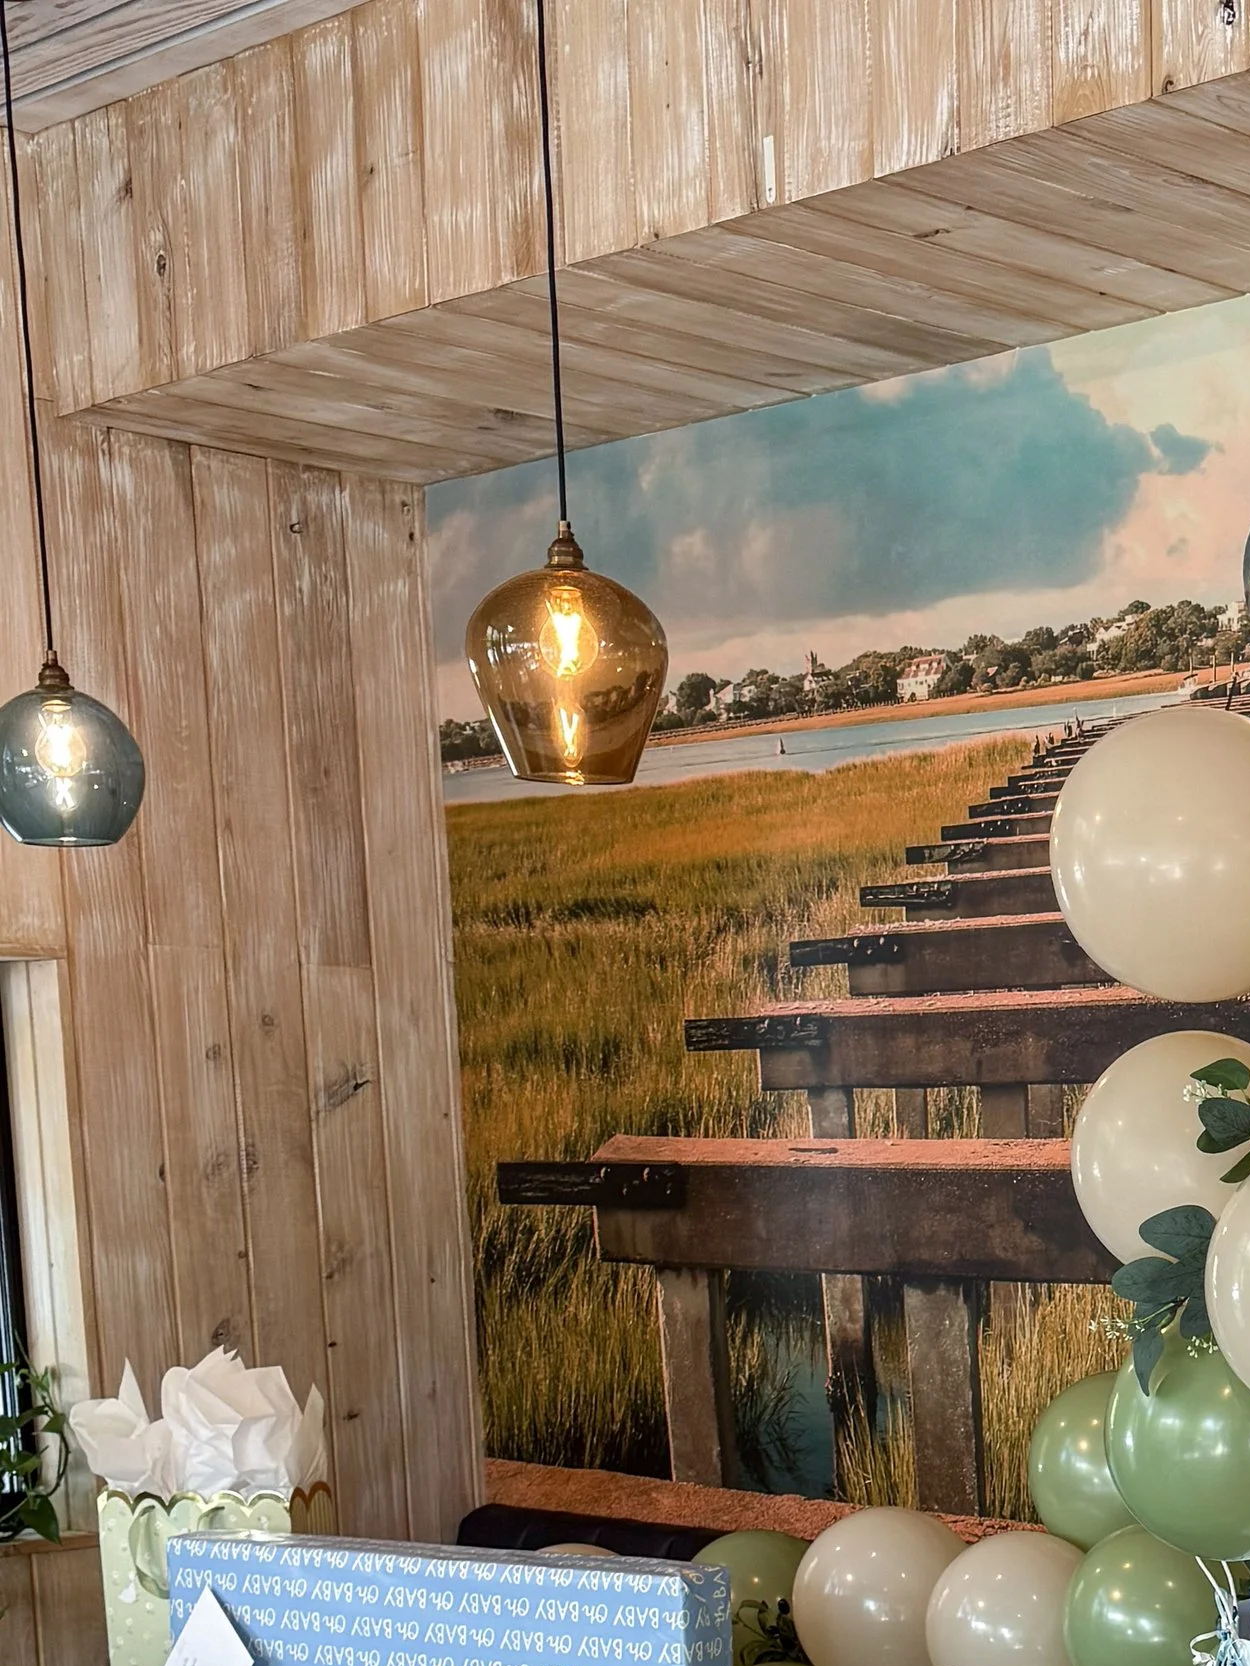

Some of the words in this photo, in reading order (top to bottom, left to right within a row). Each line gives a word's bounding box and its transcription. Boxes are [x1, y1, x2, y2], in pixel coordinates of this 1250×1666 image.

[280, 1547, 324, 1568] BABY
[323, 1550, 350, 1569] Oh
[352, 1552, 397, 1574] BABY
[396, 1556, 423, 1575] Oh
[424, 1559, 471, 1580] BABY
[471, 1562, 498, 1581] Oh
[497, 1564, 548, 1586] BABY
[547, 1568, 574, 1587] Oh
[214, 1572, 237, 1591] Oh
[242, 1573, 281, 1597] BABY
[283, 1578, 308, 1598] Oh
[576, 1569, 625, 1592] BABY
[624, 1574, 653, 1594] Oh
[311, 1580, 353, 1603] BABY
[355, 1584, 379, 1605] Oh
[383, 1586, 427, 1610] BABY
[429, 1590, 454, 1611] Oh
[458, 1592, 501, 1616] BABY
[504, 1597, 530, 1618] Oh
[534, 1598, 579, 1623] BABY
[582, 1604, 608, 1625] Oh
[252, 1607, 276, 1627] Oh
[280, 1609, 321, 1633] BABY
[322, 1614, 346, 1634] Oh
[351, 1616, 392, 1639] BABY
[613, 1605, 659, 1629] BABY
[662, 1609, 690, 1629] Oh
[394, 1621, 419, 1641] Oh
[424, 1622, 467, 1646] BABY
[470, 1627, 495, 1648] Oh
[500, 1629, 544, 1653] BABY
[286, 1643, 309, 1661] Oh
[546, 1635, 572, 1654] Oh
[577, 1635, 623, 1660] BABY
[625, 1640, 653, 1661] Oh
[658, 1640, 703, 1664] BABY
